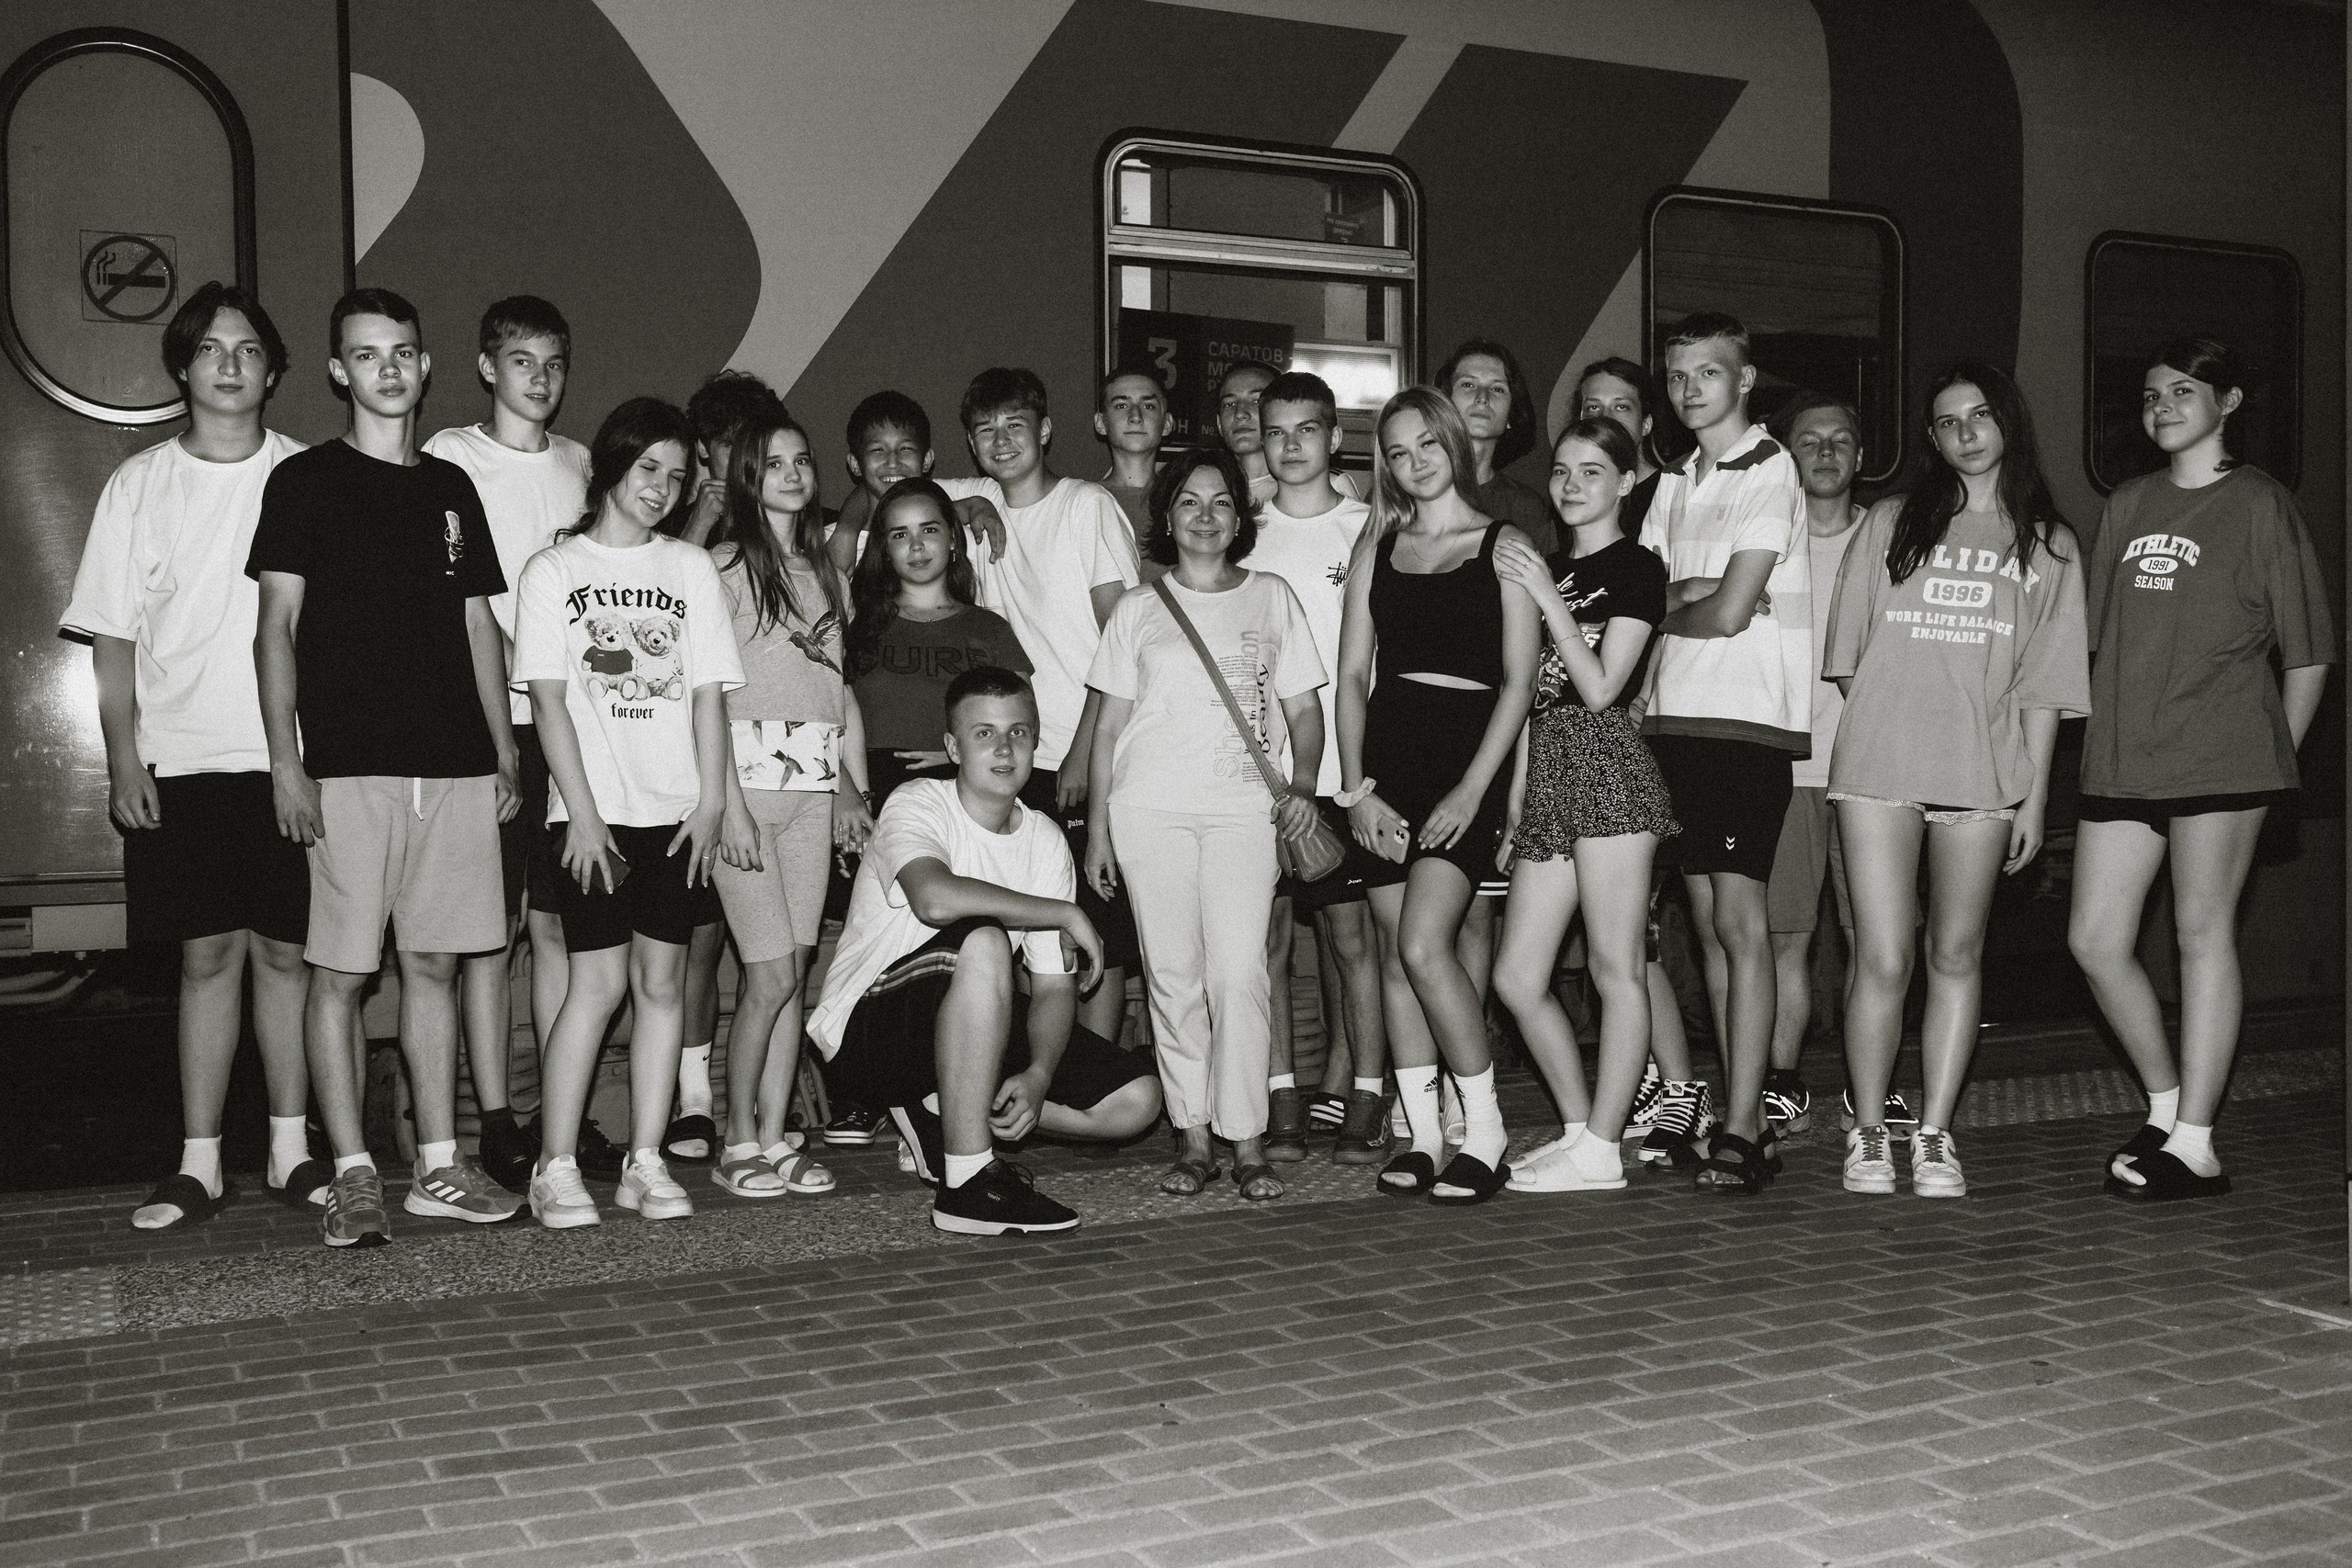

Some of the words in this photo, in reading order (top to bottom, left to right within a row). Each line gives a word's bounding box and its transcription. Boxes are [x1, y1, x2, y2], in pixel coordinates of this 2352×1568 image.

[1148, 336, 1178, 390] 3
[1208, 340, 1283, 364] САРАТОВ
[2121, 533, 2201, 568] ATHLETIC
[1883, 544, 2041, 595] LIDAY
[2147, 559, 2170, 571] 1991
[1930, 582, 1984, 604] 1996
[2134, 574, 2175, 592] SEASON
[565, 581, 688, 627] Friends
[1885, 610, 1922, 624] WORK
[1925, 612, 1957, 627] LIFE
[1910, 626, 1986, 644] ENJOYABLE
[611, 703, 655, 719] forever
[1257, 663, 1271, 754] Beauty
